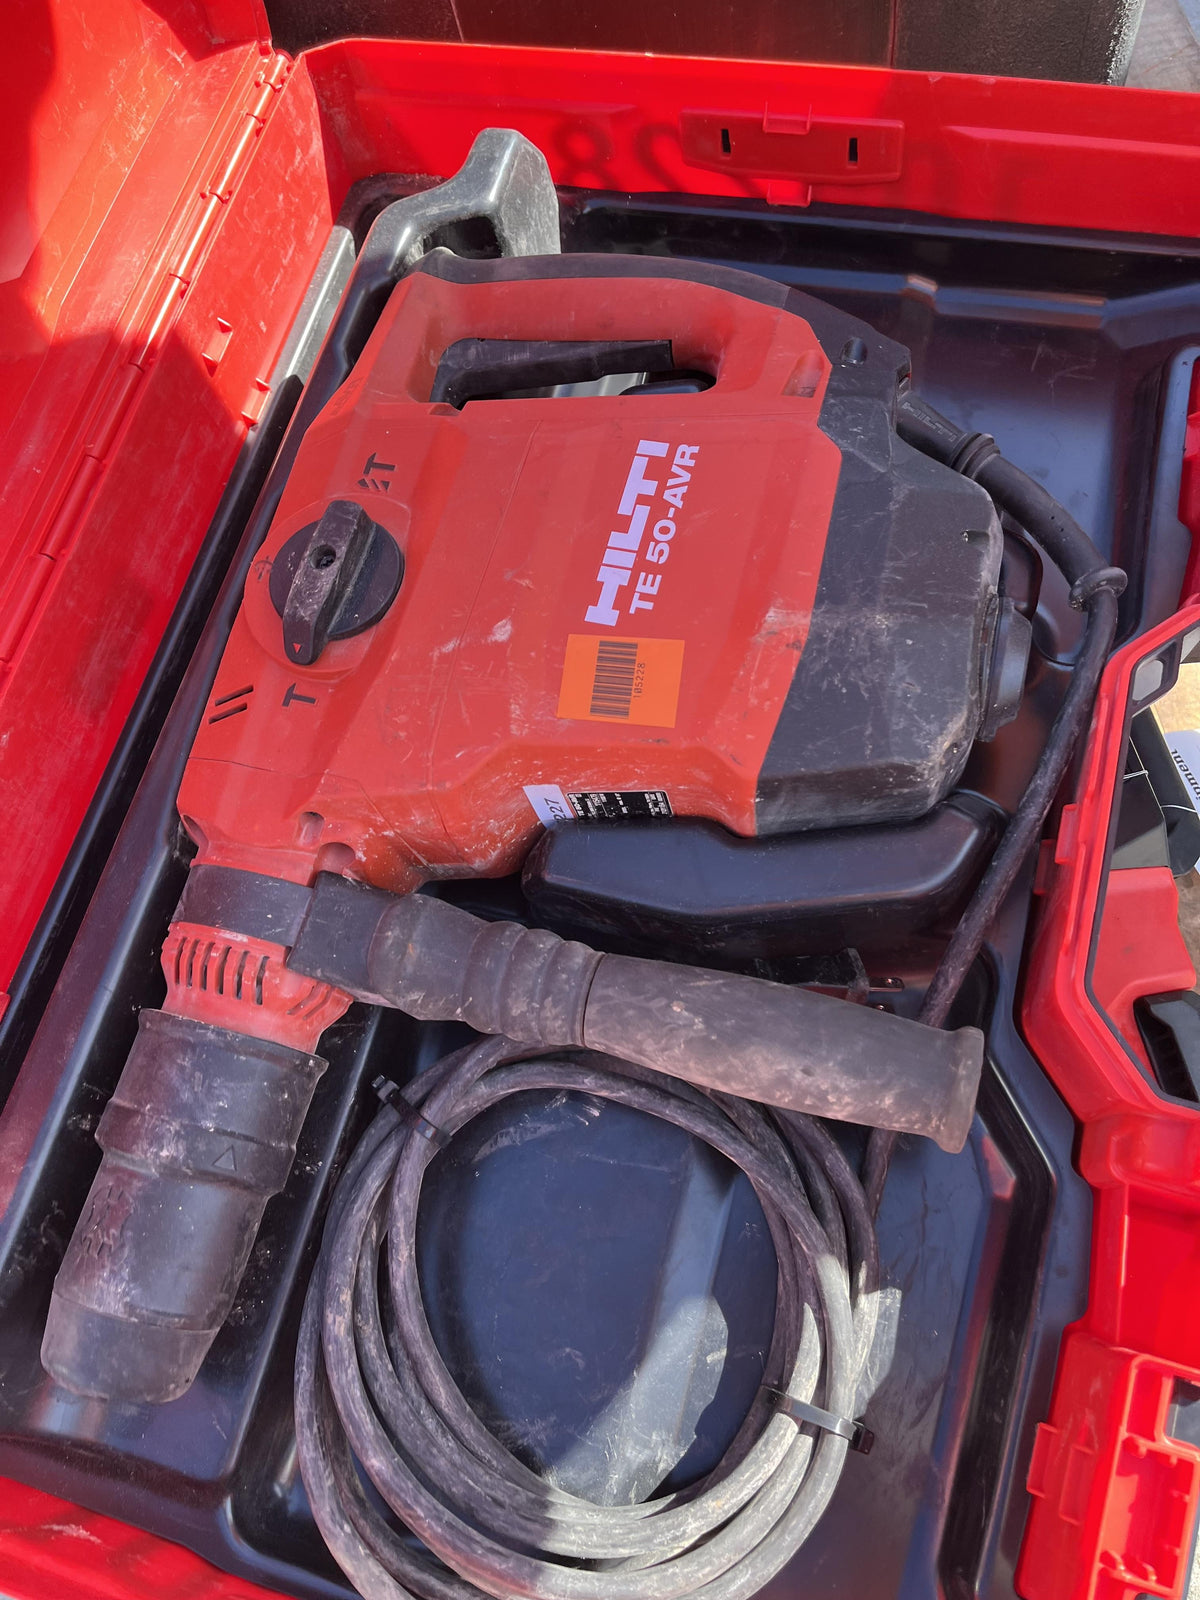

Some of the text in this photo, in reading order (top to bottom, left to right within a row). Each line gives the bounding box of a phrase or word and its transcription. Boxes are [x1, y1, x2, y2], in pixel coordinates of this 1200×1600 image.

[902, 401, 957, 442] HILTI
[584, 439, 670, 627] HILTI
[629, 444, 700, 614] TE 50-AVR
[633, 662, 646, 698] 105228
